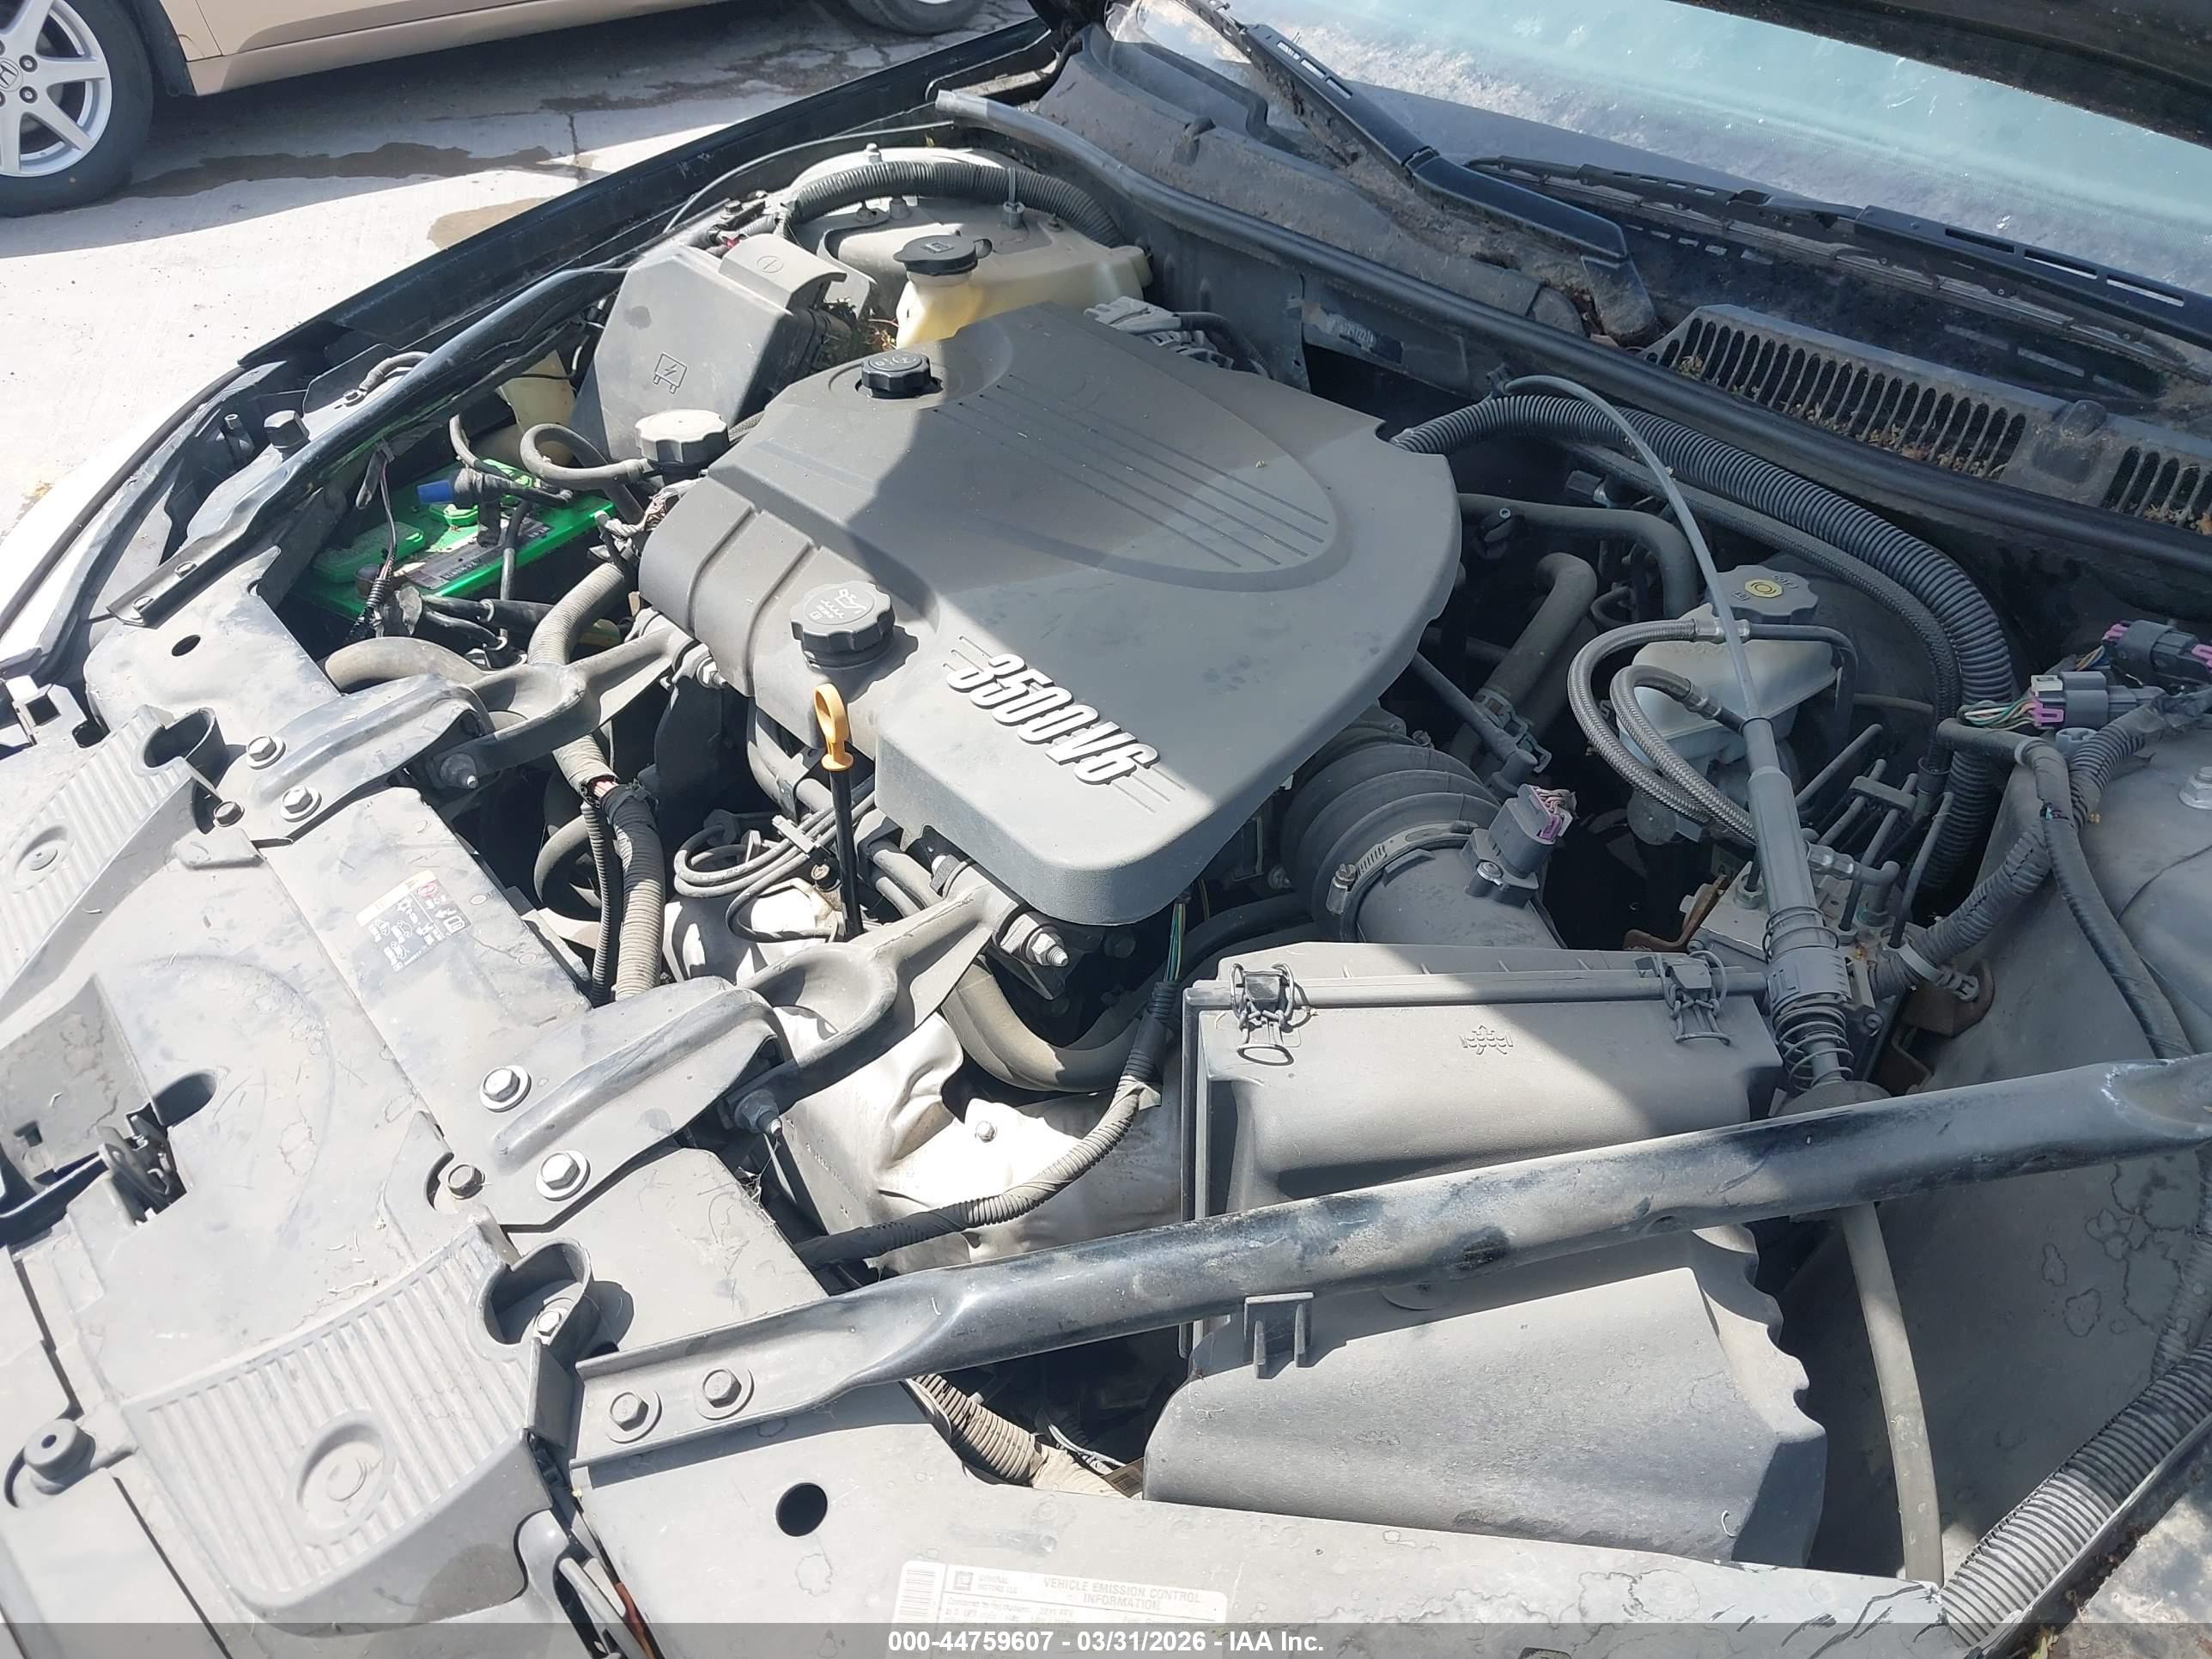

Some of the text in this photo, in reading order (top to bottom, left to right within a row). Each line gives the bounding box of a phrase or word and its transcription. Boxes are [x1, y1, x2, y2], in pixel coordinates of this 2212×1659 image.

[945, 653, 1160, 785] 3500 V6
[1043, 1577, 1202, 1603] VEHICLE EMISSION CONTROL
[1083, 1593, 1160, 1611] INFORMATION
